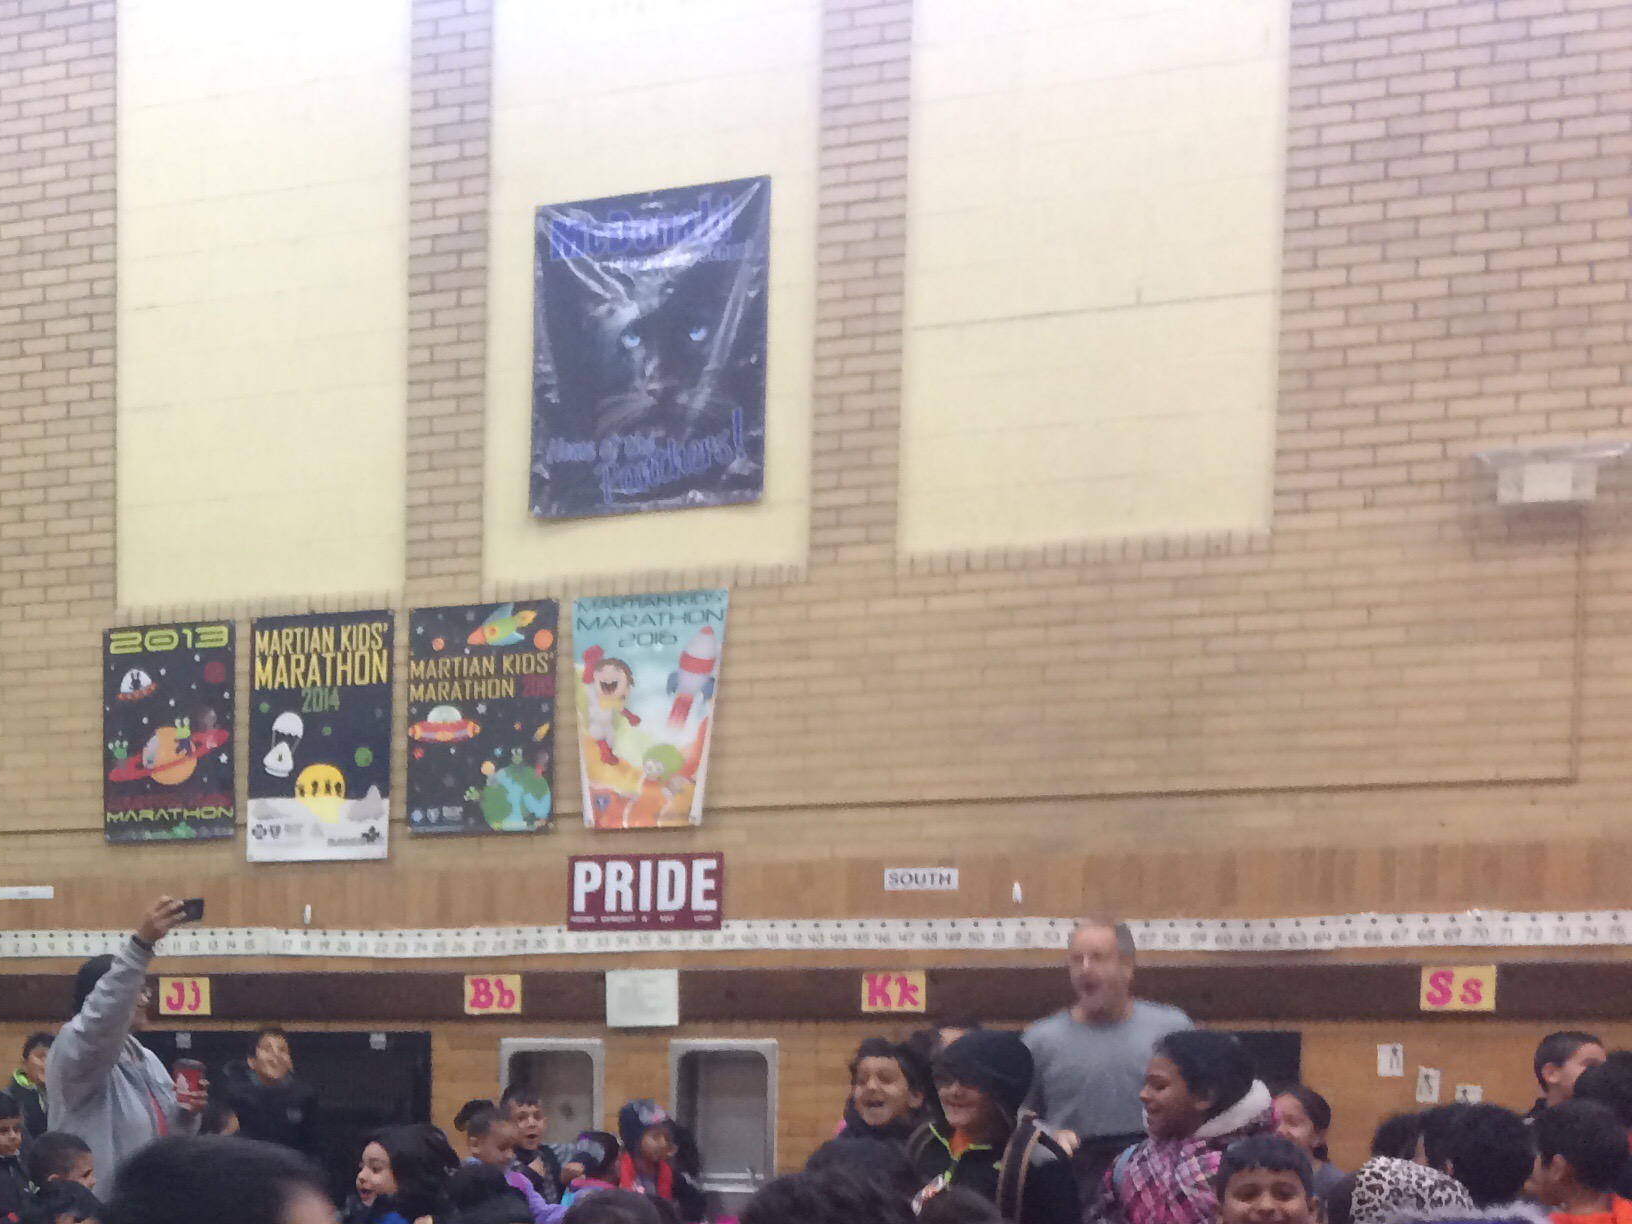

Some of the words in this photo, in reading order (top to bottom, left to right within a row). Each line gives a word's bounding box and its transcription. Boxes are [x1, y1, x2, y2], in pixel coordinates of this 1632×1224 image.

[576, 608, 724, 631] MARATHON
[109, 625, 229, 655] 2013
[254, 626, 335, 657] MARTIAN
[340, 622, 389, 651] KIDS'
[254, 648, 389, 691] MARATHON
[409, 655, 495, 680] MARTIAN
[502, 651, 554, 675] KIDS'
[301, 685, 341, 714] 2014
[409, 677, 516, 702] MARATHON
[106, 806, 234, 823] MARATHON
[572, 859, 718, 913] PRIDE
[888, 871, 952, 887] SOUTH
[166, 980, 201, 1011] Jj
[470, 978, 515, 1009] Bb
[865, 974, 919, 1007] Kk
